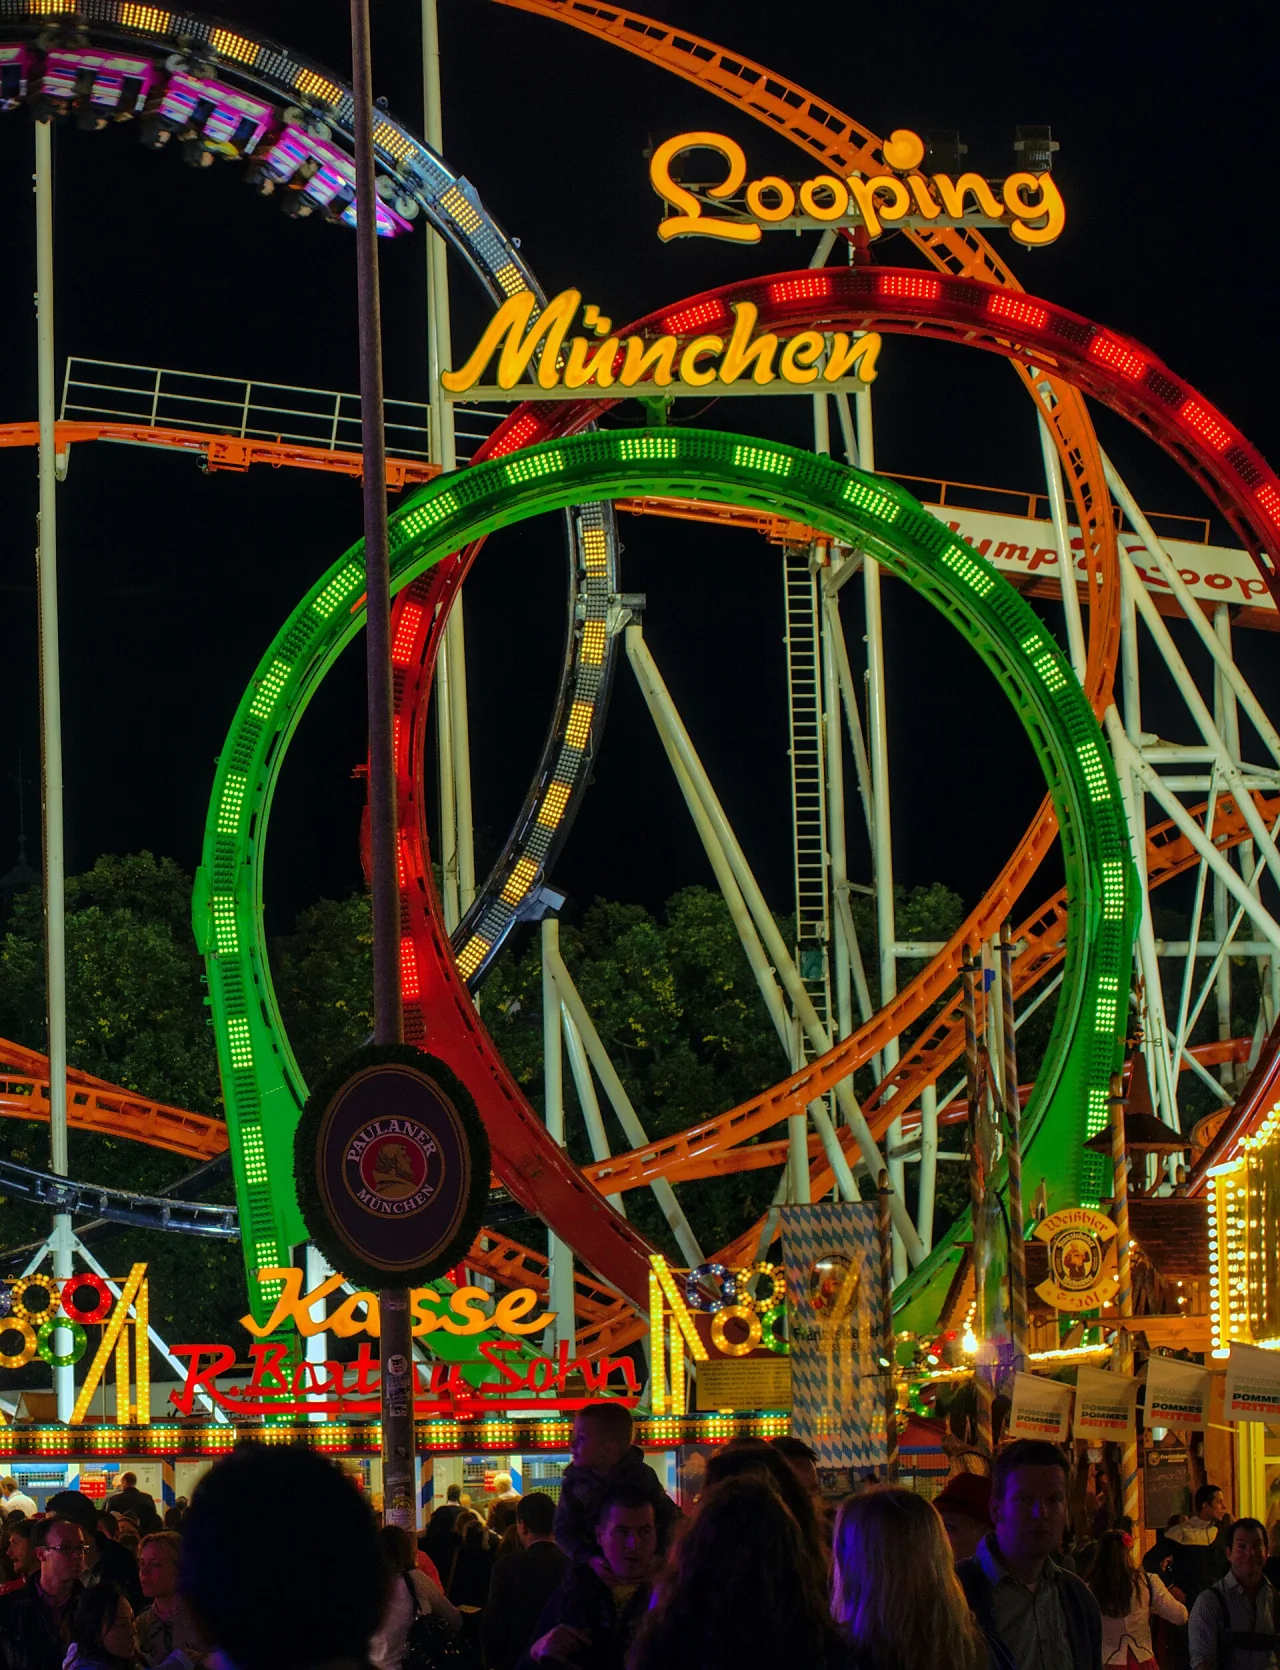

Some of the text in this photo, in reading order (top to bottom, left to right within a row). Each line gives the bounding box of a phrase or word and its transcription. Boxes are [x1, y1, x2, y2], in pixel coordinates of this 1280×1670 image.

[649, 128, 1067, 247] Looping
[440, 286, 883, 393] München
[346, 1119, 437, 1163] PAULANER
[356, 1183, 435, 1215] MÜNCHEN
[1043, 1211, 1108, 1232] Weißbier
[239, 1267, 556, 1338] Kasse
[479, 1340, 642, 1394] Sohn
[1017, 1415, 1060, 1426] POMMES
[1082, 1411, 1128, 1421] POMMES
[1151, 1402, 1202, 1413] POMMES
[1151, 1409, 1201, 1423] FRITES
